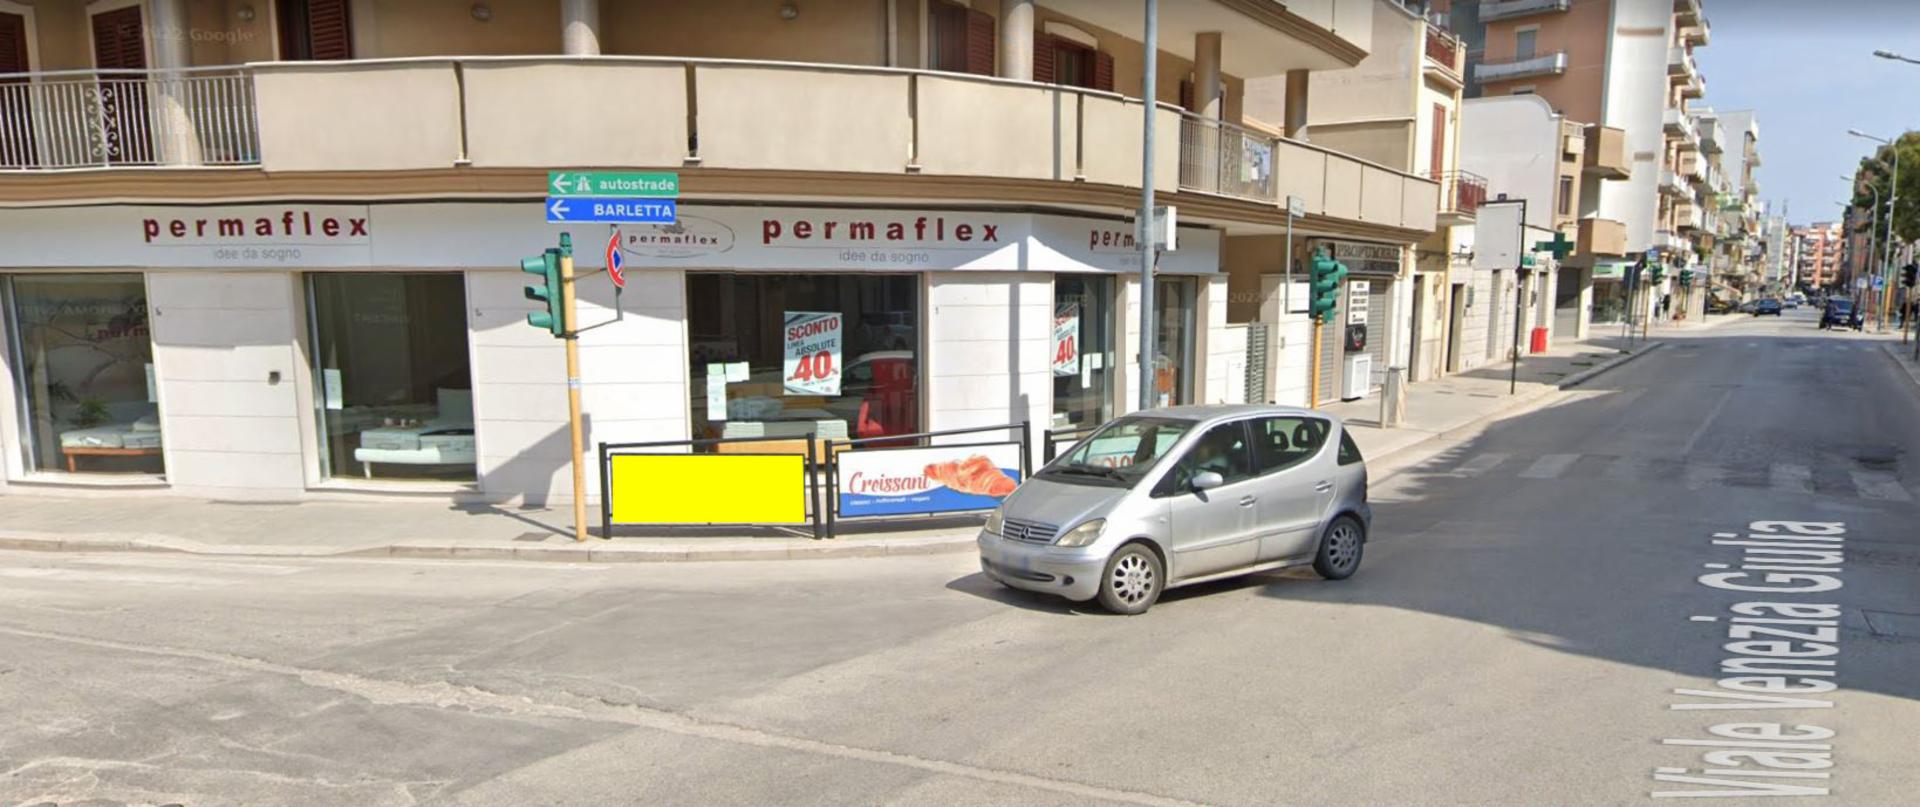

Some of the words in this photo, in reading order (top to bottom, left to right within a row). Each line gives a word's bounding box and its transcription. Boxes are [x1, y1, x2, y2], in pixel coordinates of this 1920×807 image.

[599, 177, 676, 191] autostrade
[593, 203, 673, 217] BARLETTA
[143, 211, 368, 243] permaflex
[762, 217, 999, 245] permaflex
[629, 233, 718, 245] permaflex
[213, 247, 238, 260] idee
[242, 247, 259, 260] da
[261, 248, 301, 262] sogno
[839, 249, 867, 262] idee
[870, 250, 887, 263] da
[890, 252, 930, 266] sogno
[787, 316, 839, 342] SCONTO
[795, 338, 837, 357] ABSOLUTE
[848, 470, 931, 495] Croissant
